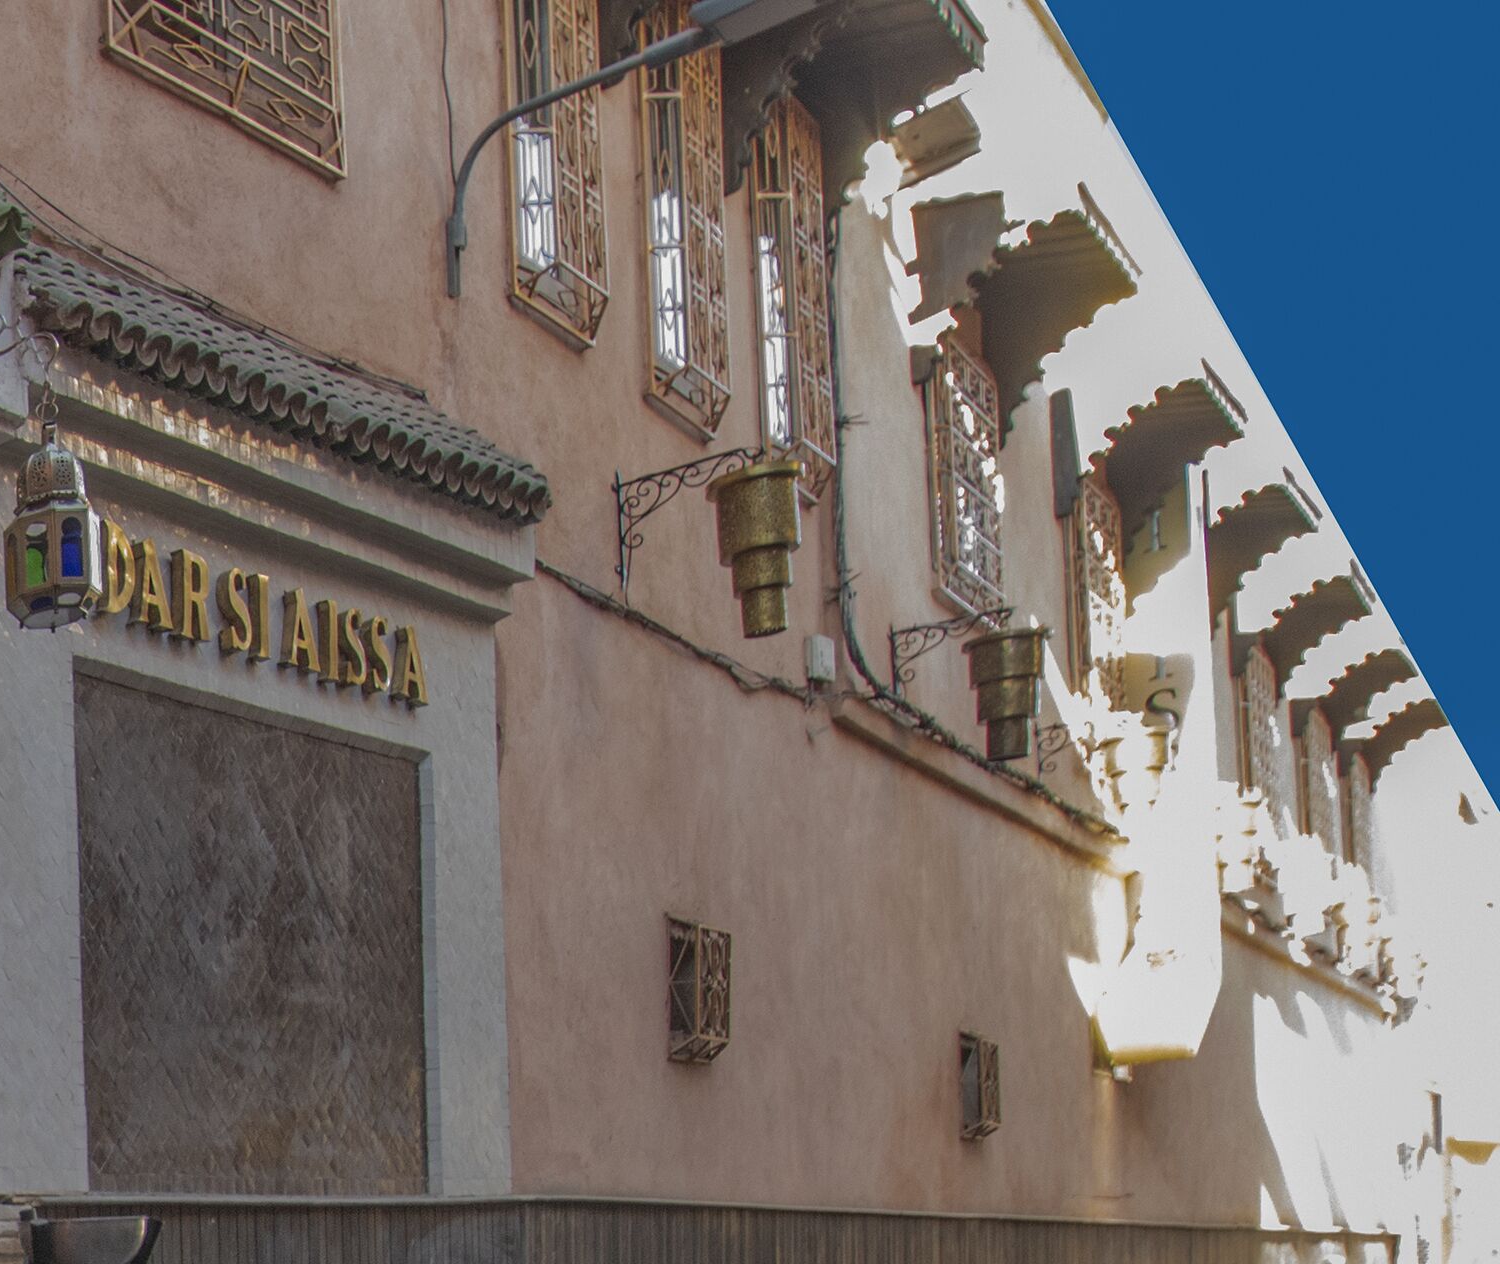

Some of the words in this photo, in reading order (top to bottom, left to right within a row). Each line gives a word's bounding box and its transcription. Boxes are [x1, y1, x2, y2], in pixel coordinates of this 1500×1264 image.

[97, 519, 210, 642] DAR
[216, 567, 271, 662] SI
[278, 587, 429, 709] AISSA
